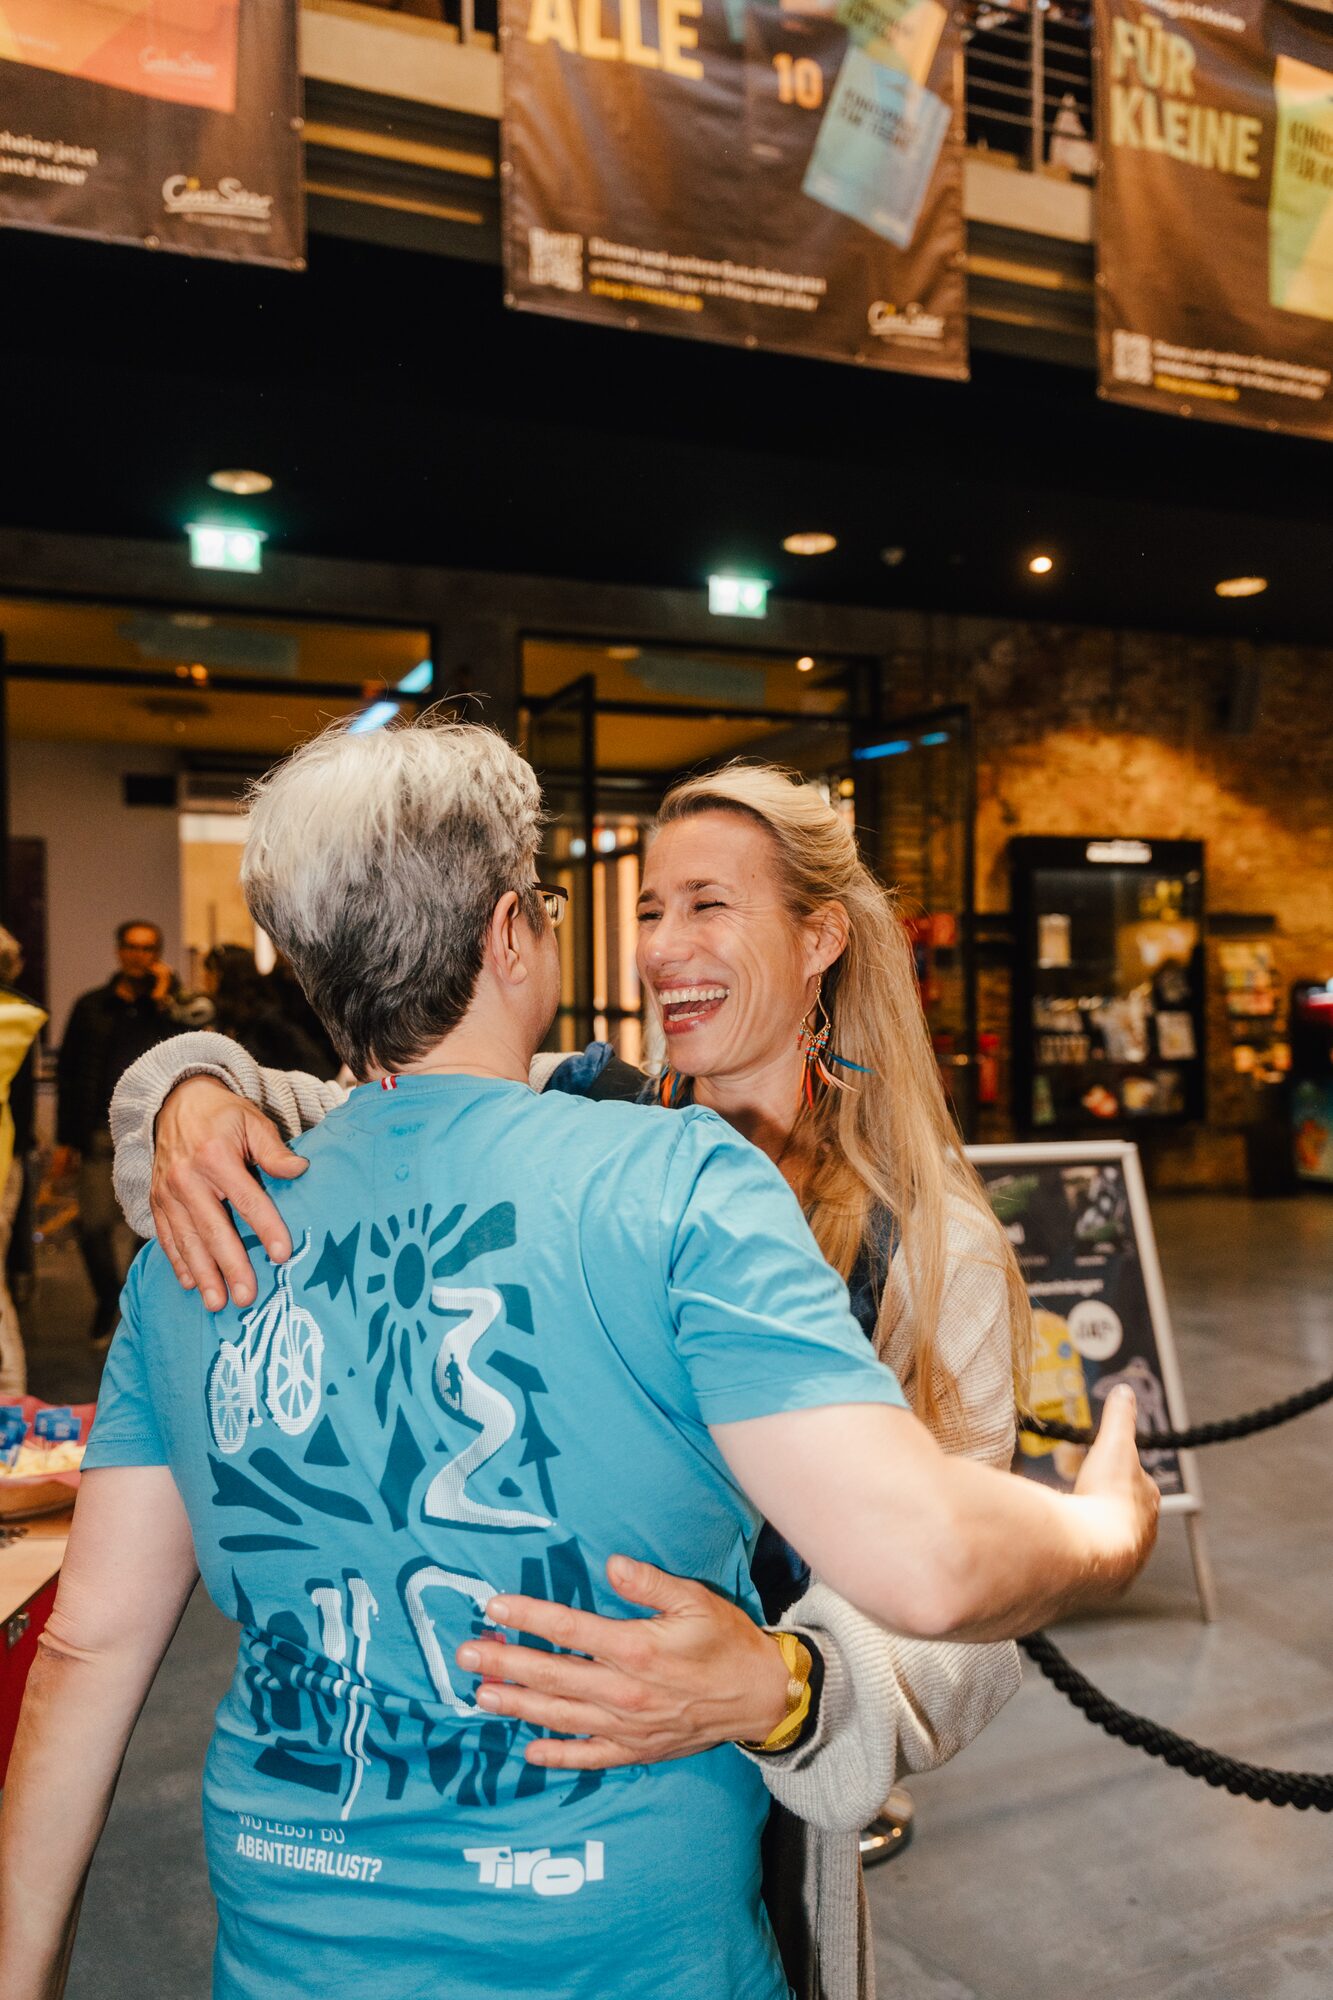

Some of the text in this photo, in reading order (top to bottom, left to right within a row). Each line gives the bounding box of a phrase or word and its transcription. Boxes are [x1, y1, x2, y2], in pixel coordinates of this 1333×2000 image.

[527, 0, 704, 81] ALLE
[1111, 13, 1196, 96] FÜR
[773, 52, 823, 109] 10
[1110, 84, 1262, 180] KLEINE
[236, 1832, 383, 1882] ABENTEUERLUST?
[463, 1840, 604, 1896] Tirol
